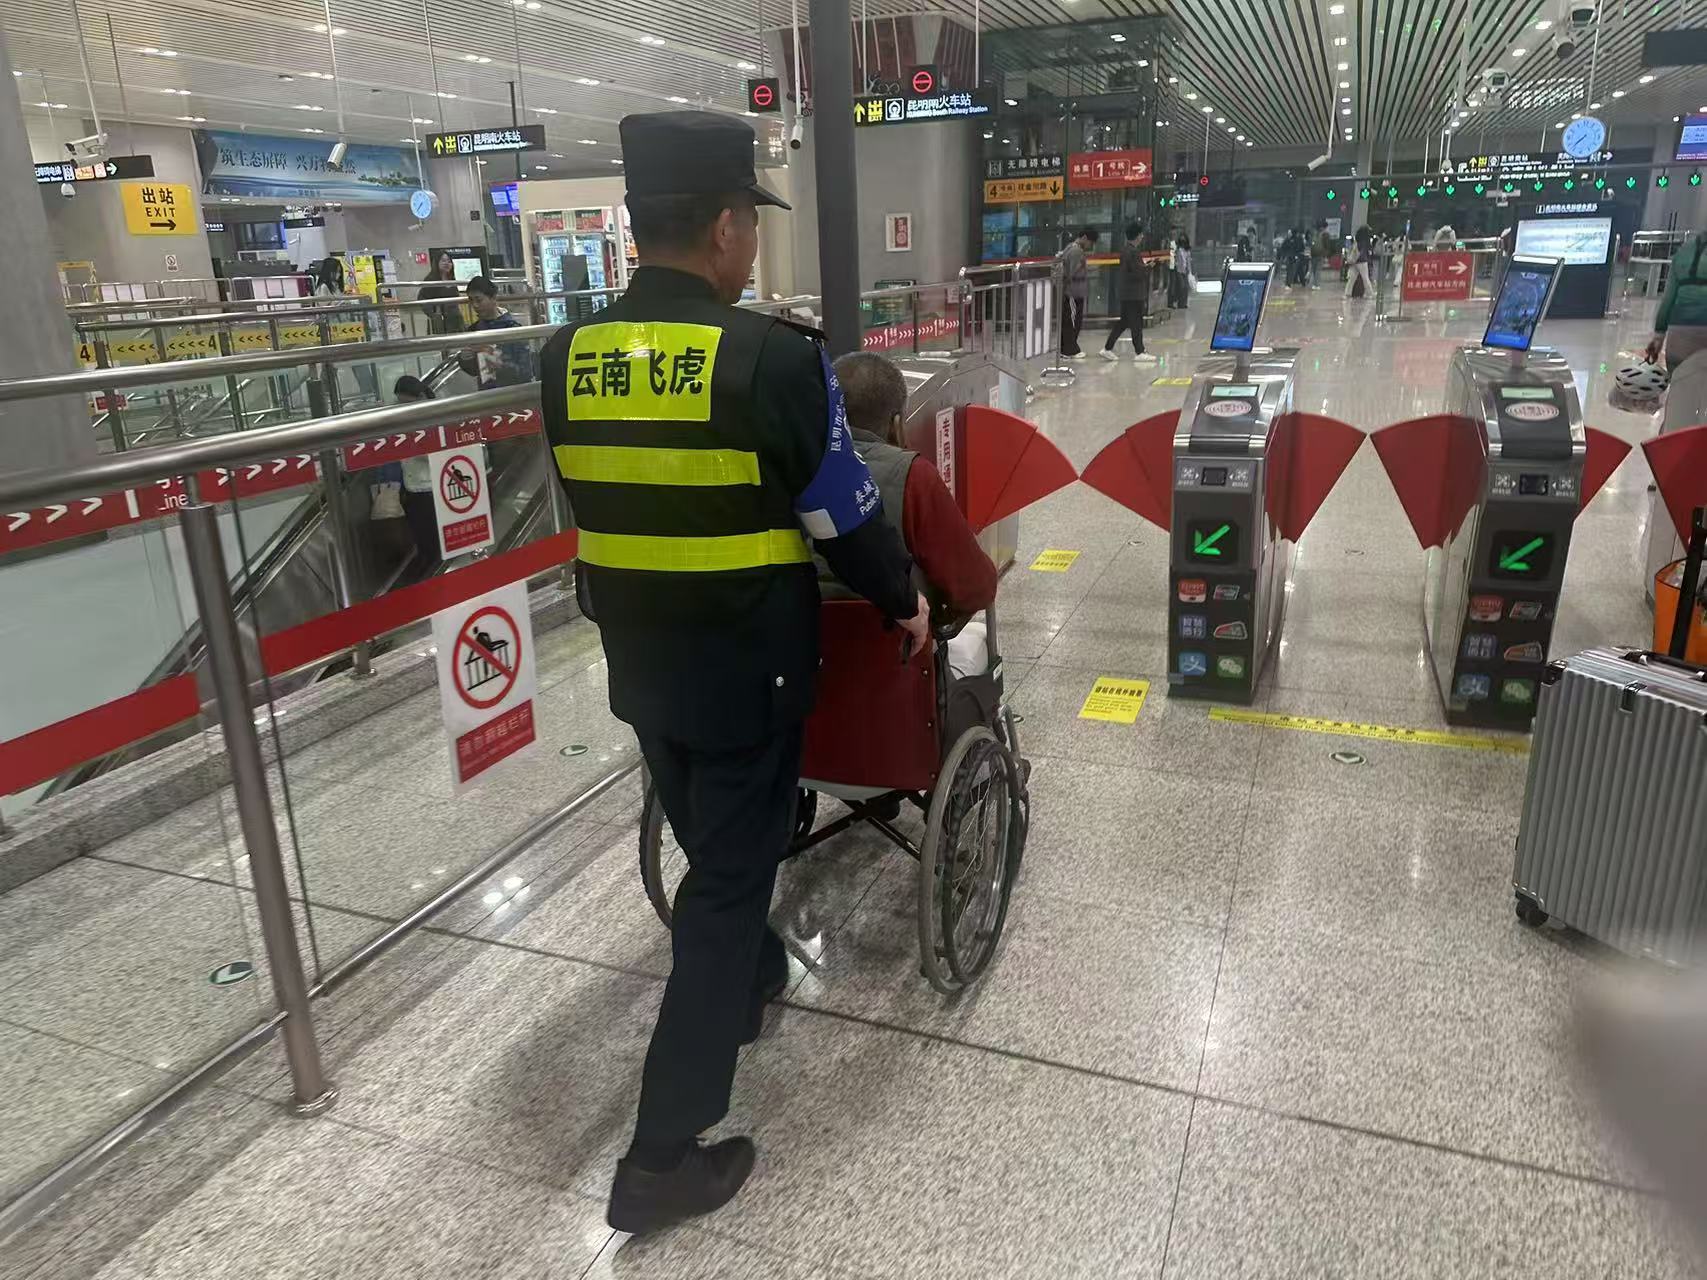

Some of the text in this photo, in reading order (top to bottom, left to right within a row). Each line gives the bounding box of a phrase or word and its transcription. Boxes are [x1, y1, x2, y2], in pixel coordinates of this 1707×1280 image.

[868, 93, 972, 115] 出 昆明南火车站
[948, 106, 969, 116] Railway
[969, 105, 989, 113] Station
[1008, 157, 1061, 169] 无障碍电梯
[1096, 162, 1105, 178] 1
[142, 187, 175, 205] 出站
[989, 186, 998, 198] 4
[145, 207, 175, 218] EXIT
[1412, 263, 1419, 276] 1
[209, 334, 217, 351] 4
[80, 344, 91, 362] 4
[571, 347, 706, 397] 云南飞虎
[456, 430, 476, 443] Line
